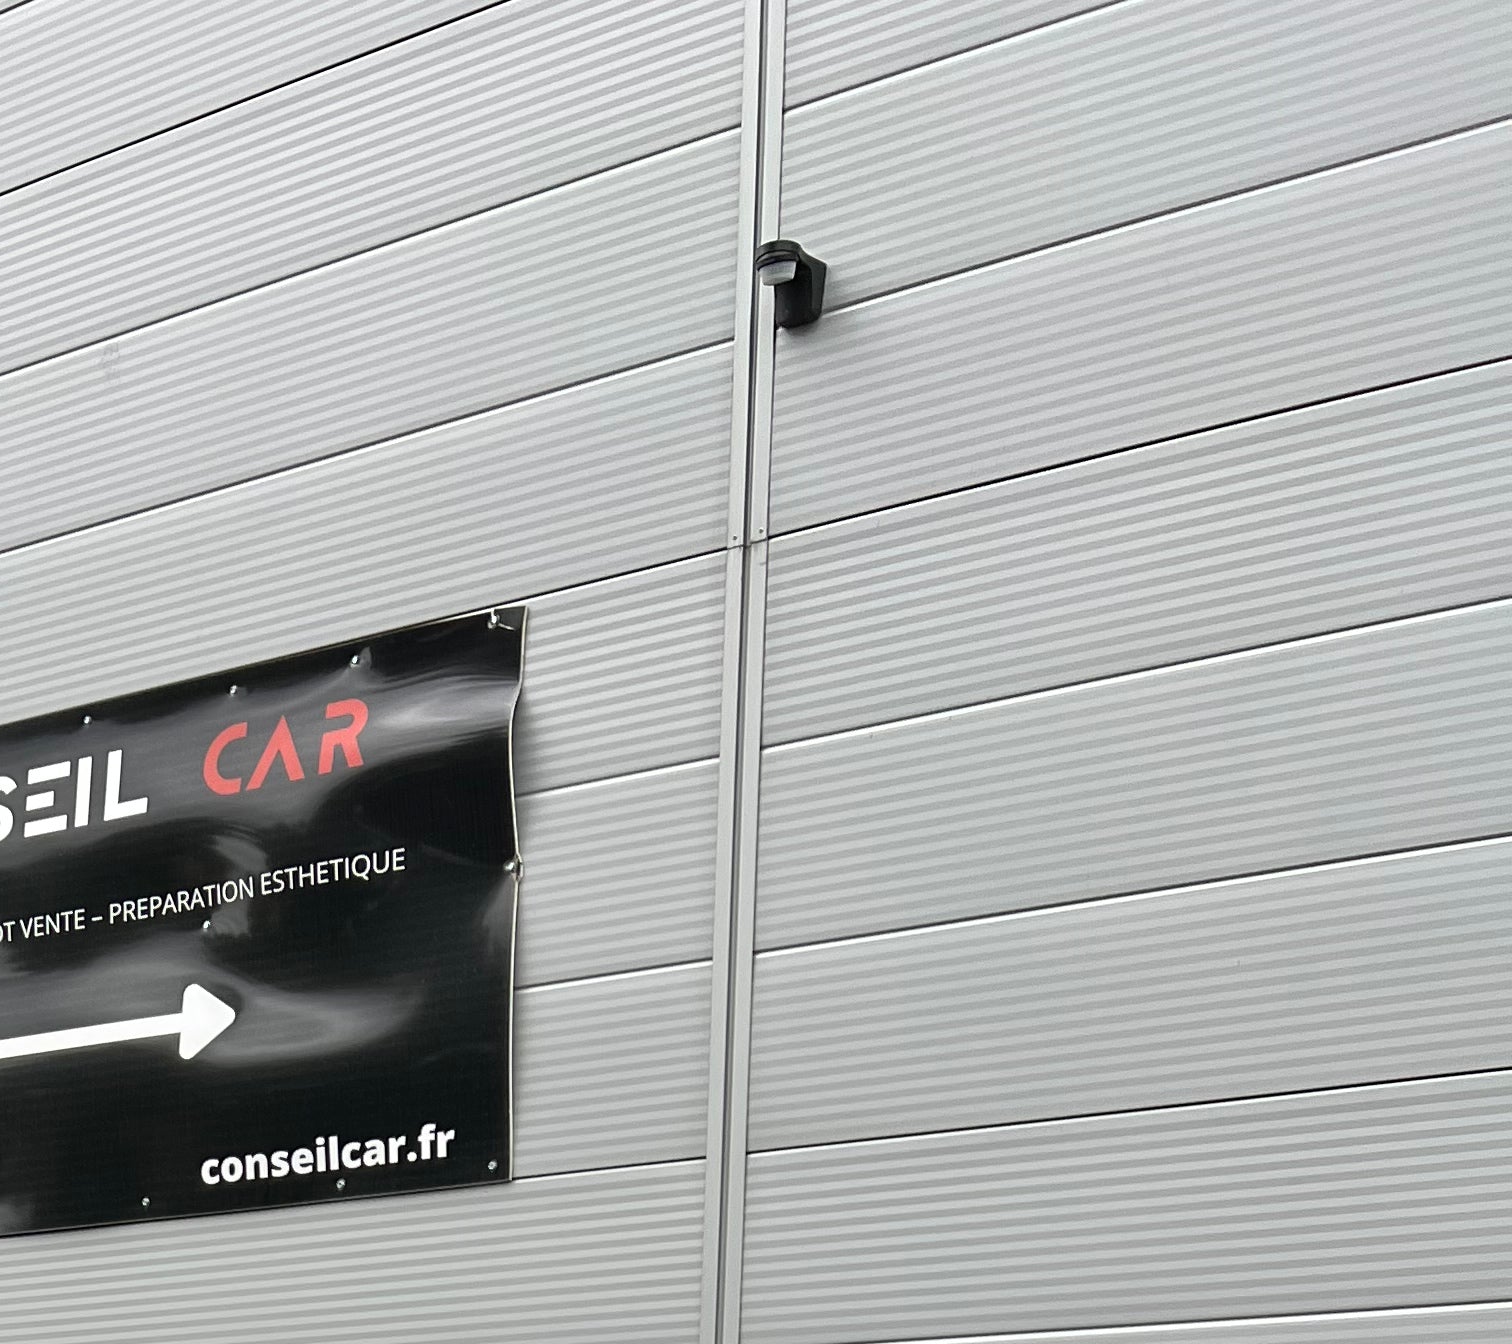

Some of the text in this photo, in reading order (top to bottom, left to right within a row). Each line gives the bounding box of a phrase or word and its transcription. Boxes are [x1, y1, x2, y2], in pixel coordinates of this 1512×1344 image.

[203, 698, 370, 796] CAR
[19, 908, 85, 939] VENTE
[109, 876, 255, 925] PREPARATION
[260, 848, 406, 895] ESTHETIQUE
[201, 1123, 456, 1186] conseilcar.fr
